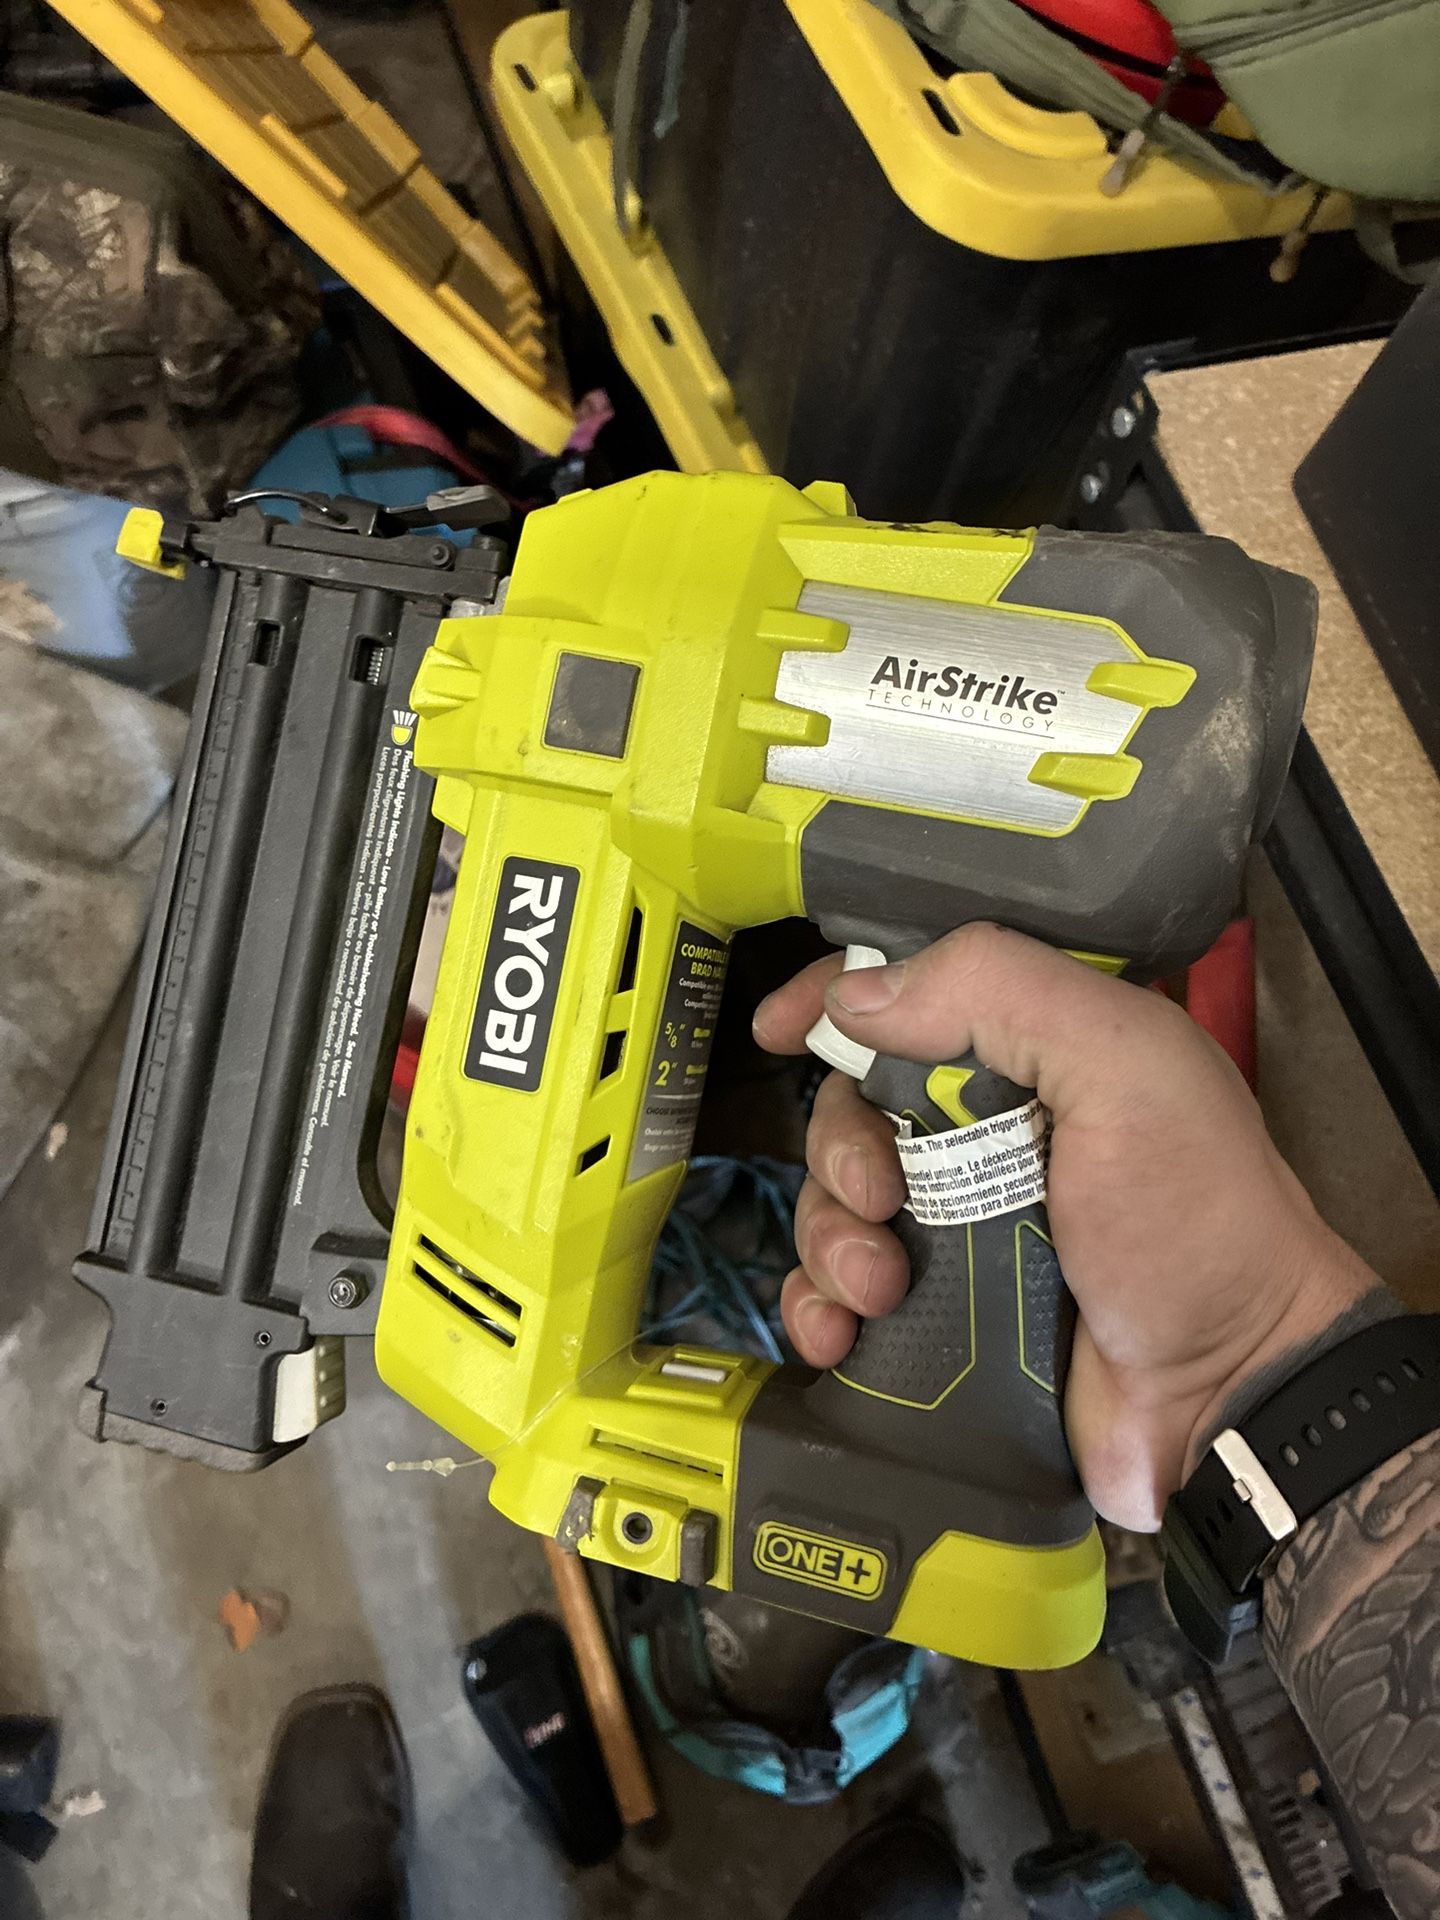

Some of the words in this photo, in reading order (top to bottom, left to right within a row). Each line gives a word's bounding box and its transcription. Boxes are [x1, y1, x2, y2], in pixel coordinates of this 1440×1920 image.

[868, 688, 1054, 731] TECHNOLOGY
[379, 746, 391, 771] Luces
[392, 748, 402, 766] Des
[397, 750, 414, 789] Flashing
[387, 767, 399, 787] feux
[366, 772, 384, 837] parpadeantes
[377, 789, 394, 838] clignotants
[393, 790, 406, 818] Lights
[385, 820, 400, 857] Indicate
[359, 839, 373, 873] indican
[369, 840, 385, 885] indiquent
[380, 865, 392, 885] Low
[364, 892, 373, 911] pile
[372, 885, 388, 919] Battery
[346, 916, 358, 938] baja
[358, 912, 370, 939] faible
[371, 920, 379, 932] or
[355, 940, 363, 953] ou
[335, 947, 350, 995] necesidad
[349, 954, 362, 985] besoin
[354, 933, 378, 1006] Troubleshooting
[479, 874, 564, 1075] RYOBI
[690, 961, 713, 976] BRAD
[332, 995, 342, 1008] de
[346, 986, 355, 999] de
[350, 1007, 363, 1036] Need.
[322, 1049, 331, 1061] de
[346, 1040, 357, 1058] See
[331, 1059, 341, 1078] Voir
[338, 1058, 353, 1097] Manual.
[312, 1062, 327, 1114] problemas.
[328, 1079, 338, 1088] le
[321, 1089, 333, 1127] manuel.
[304, 1116, 318, 1155] Consulte
[926, 1140, 944, 1152] The
[945, 1126, 989, 1148] selectable
[989, 1115, 1018, 1133] trigger
[302, 1157, 309, 1167] el
[928, 1175, 972, 1192] instruction
[973, 1162, 1017, 1186] détaillées
[1017, 1153, 1036, 1173] pour
[933, 1164, 968, 1182] unique.
[968, 1159, 981, 1173] Le
[293, 1167, 306, 1205] manual.
[939, 1183, 1003, 1208] accionamiento
[940, 1205, 979, 1222] Operador
[980, 1198, 1003, 1216] para
[1003, 1188, 1037, 1207] obtener
